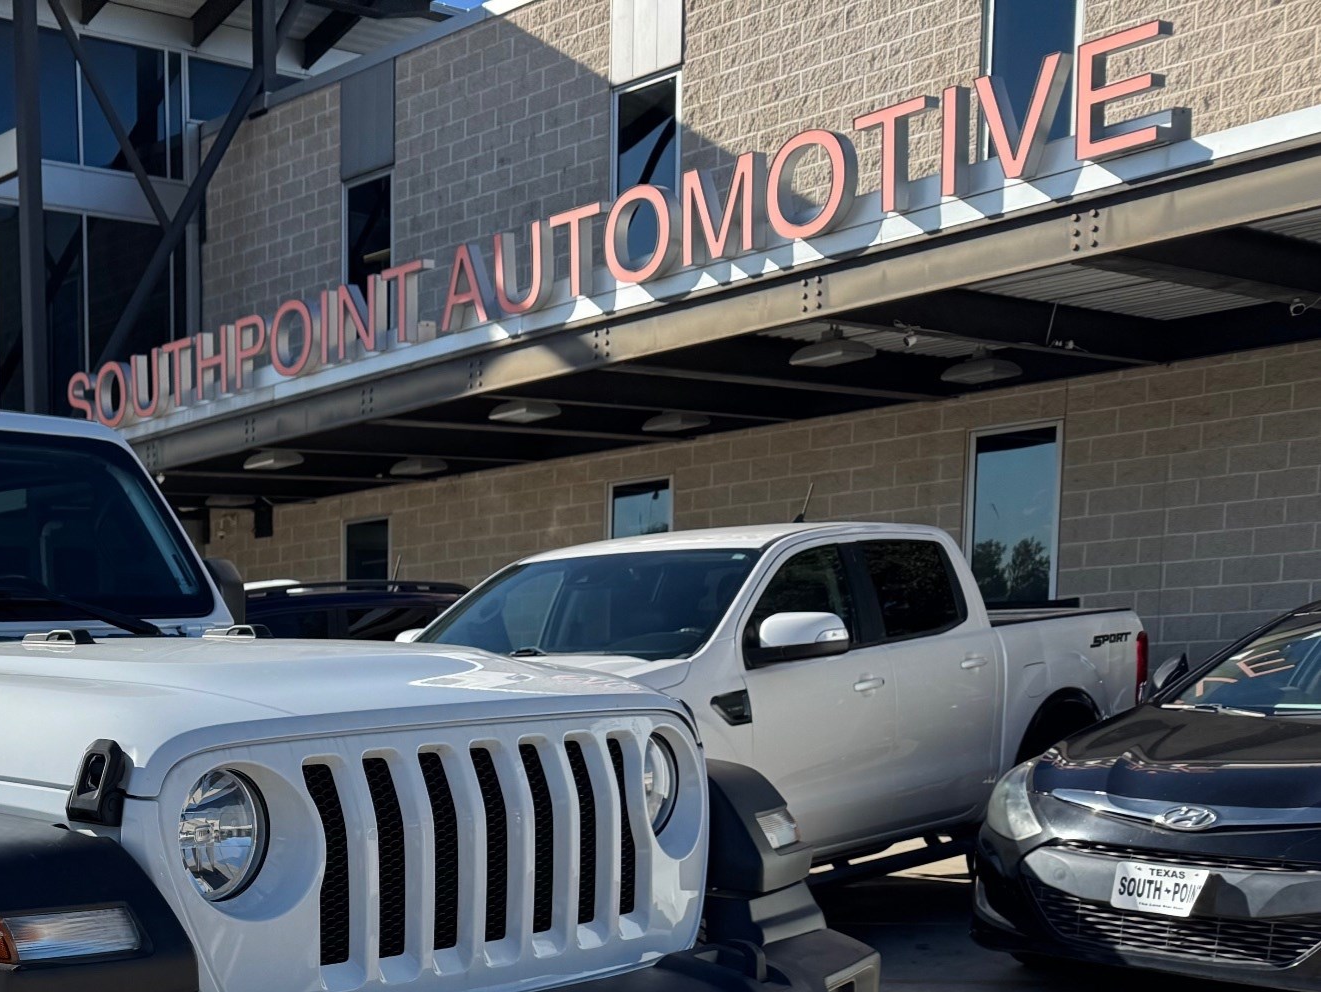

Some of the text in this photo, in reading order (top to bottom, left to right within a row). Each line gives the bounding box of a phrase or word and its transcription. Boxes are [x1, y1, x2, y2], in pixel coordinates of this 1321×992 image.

[67, 20, 1172, 429] SOUTHPOINT AUTOMOTIVE
[1090, 631, 1132, 648] SPORT
[1149, 867, 1186, 880] TEXAS
